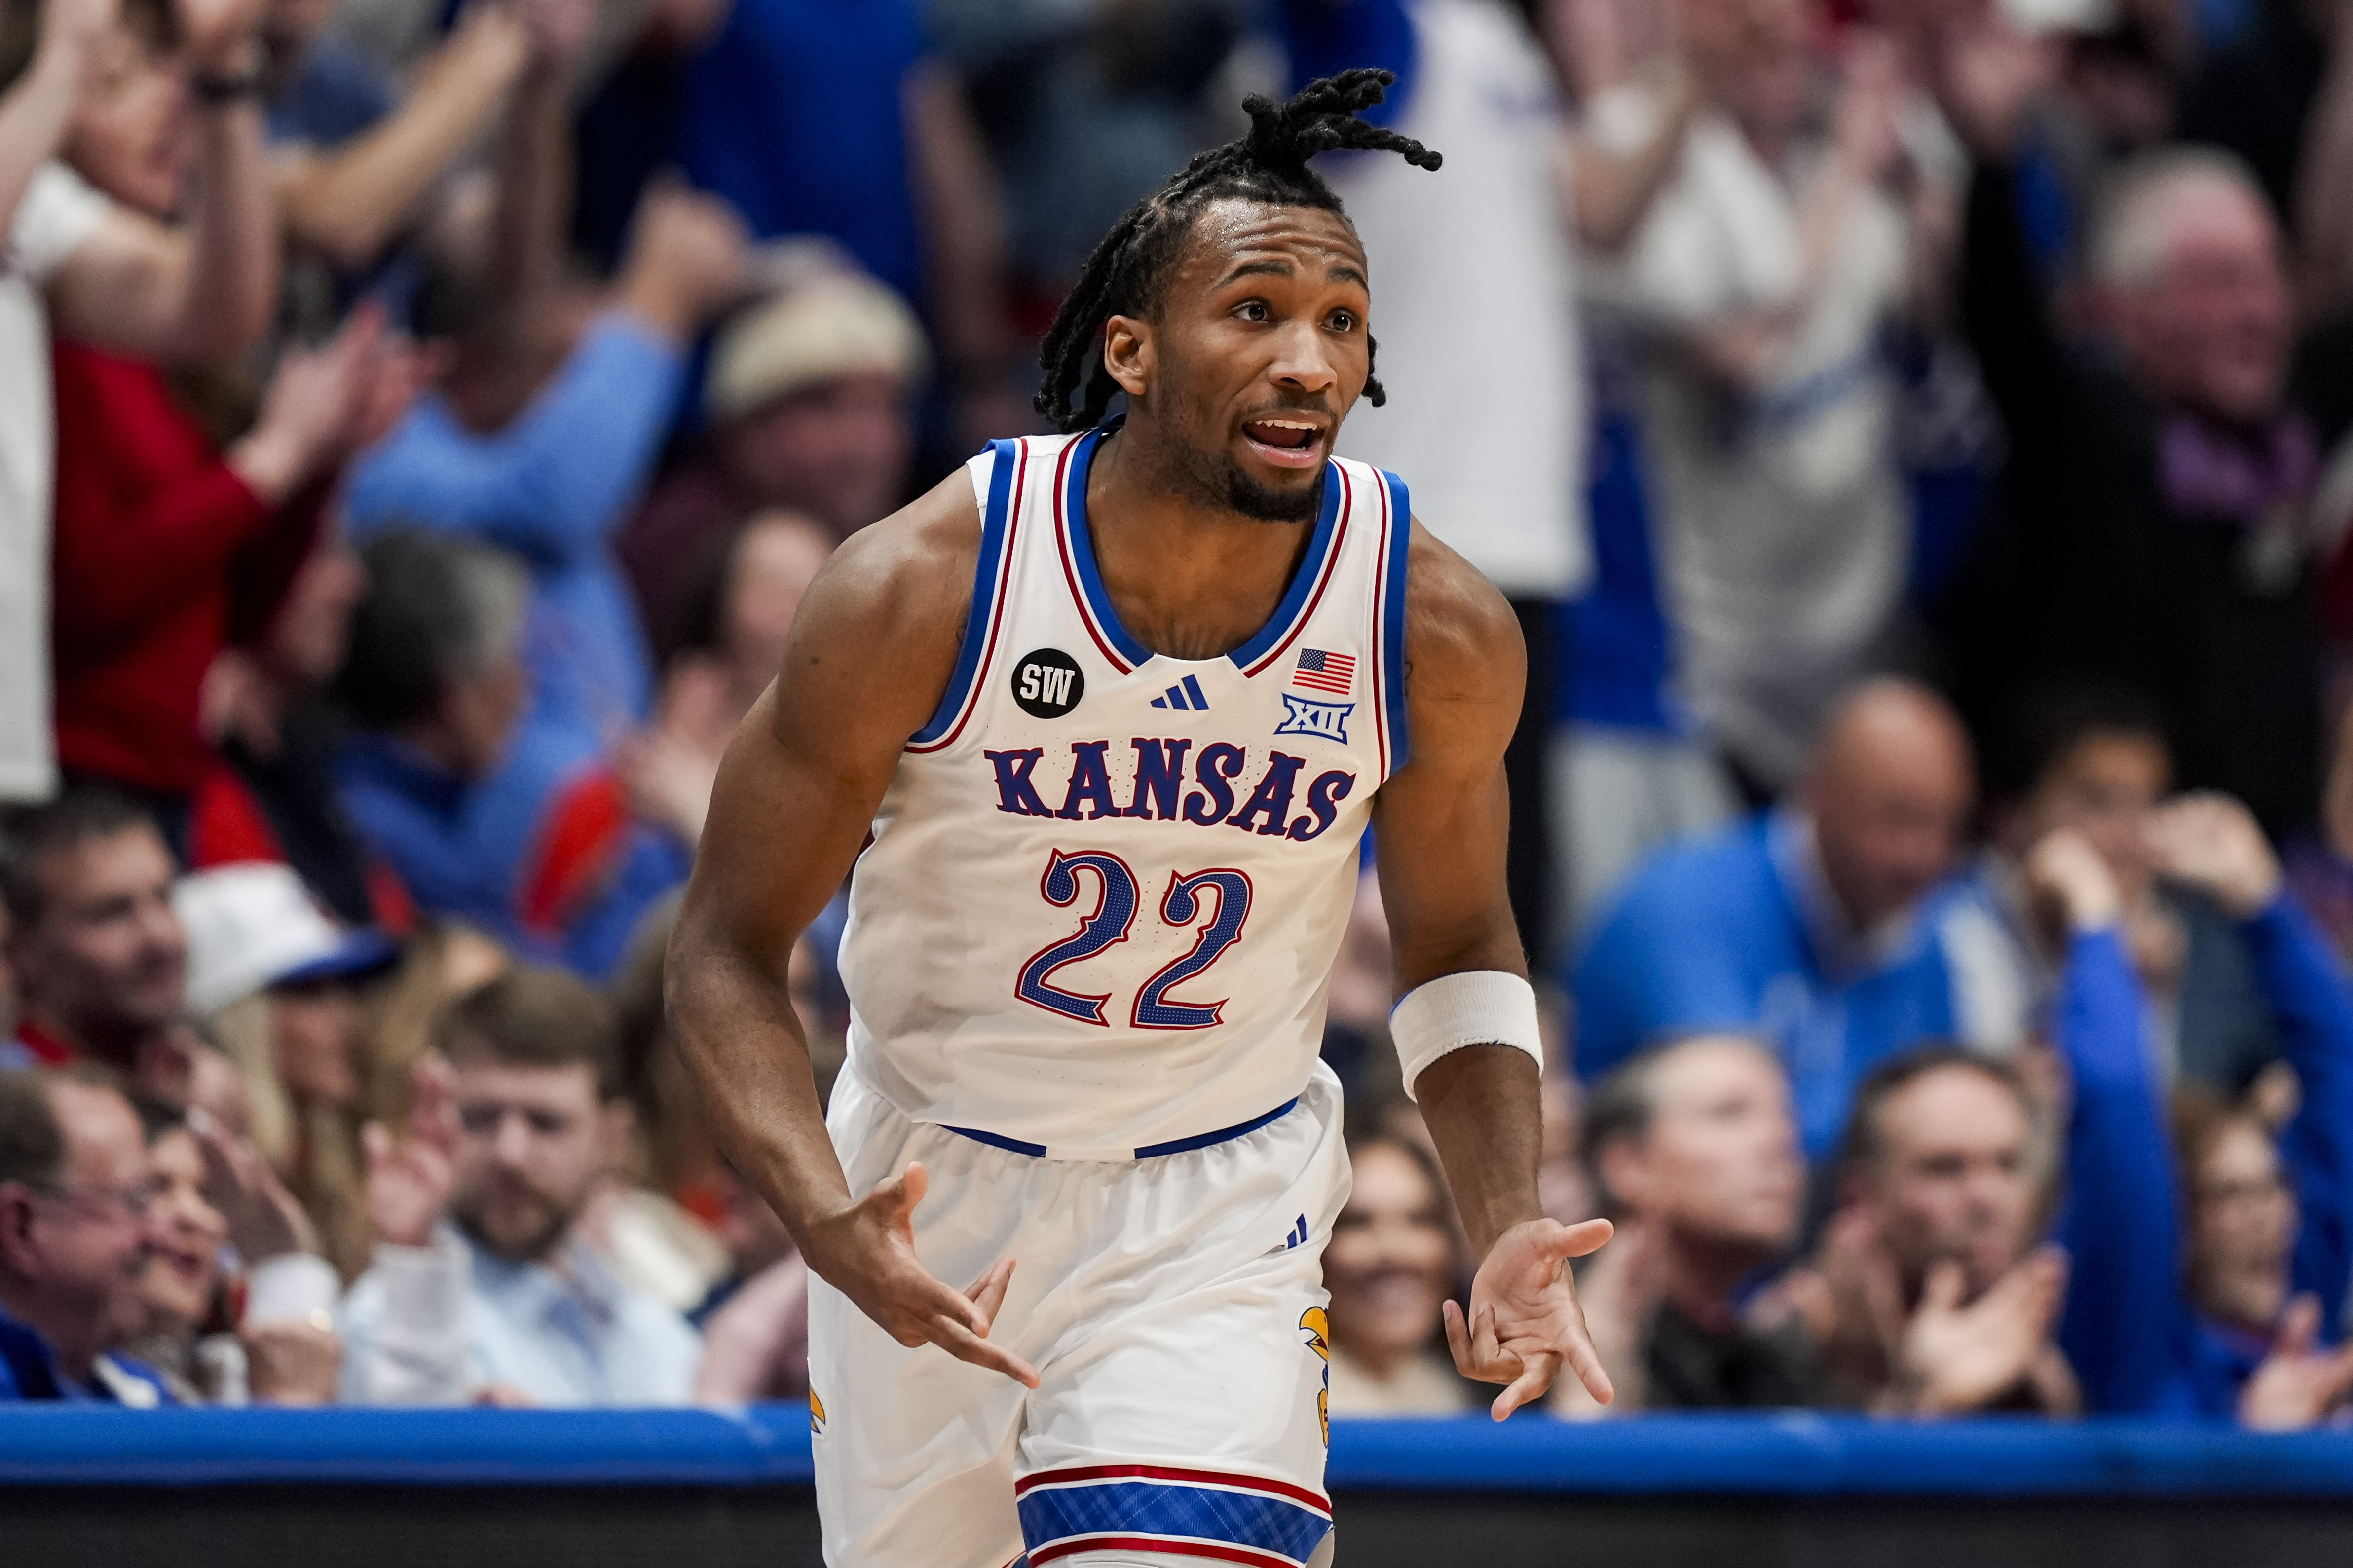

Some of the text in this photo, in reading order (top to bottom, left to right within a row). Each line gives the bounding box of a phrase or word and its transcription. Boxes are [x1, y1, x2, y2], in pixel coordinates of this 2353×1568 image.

[1019, 663, 1075, 706] SW
[983, 737, 1357, 842] KANSAS
[1014, 848, 1253, 1030] 22
